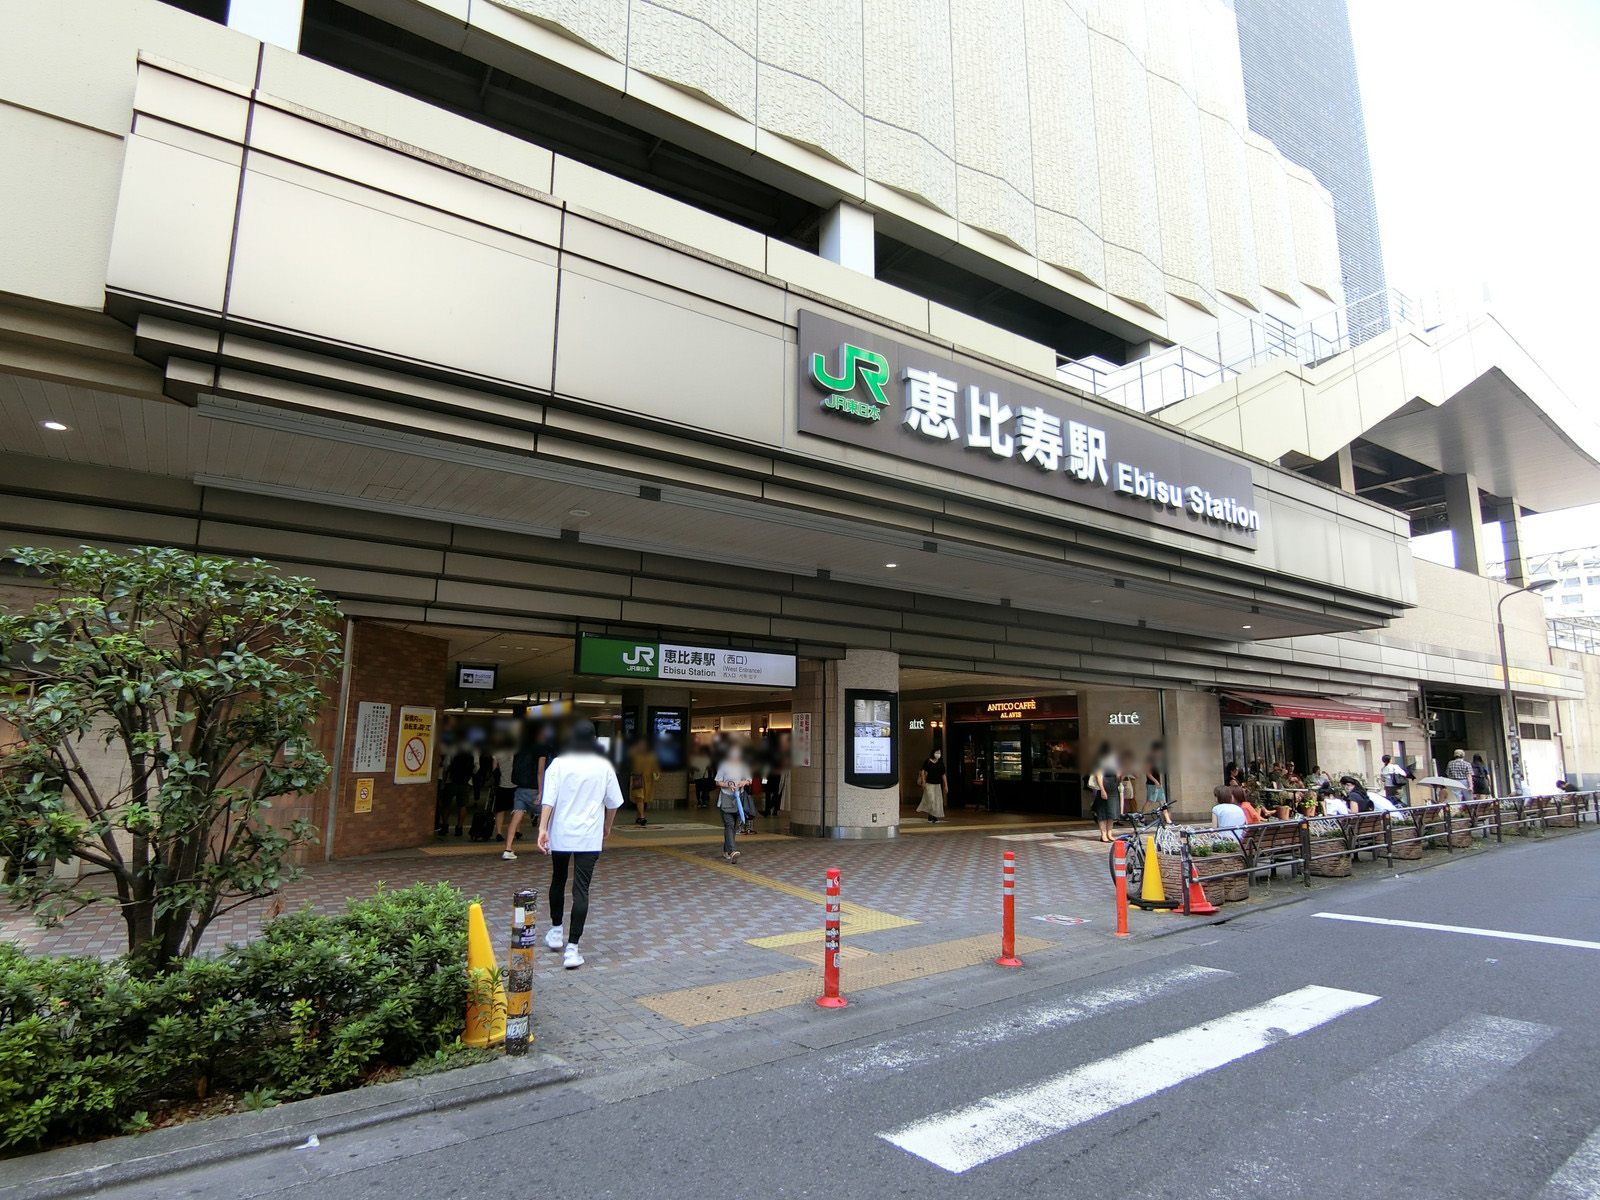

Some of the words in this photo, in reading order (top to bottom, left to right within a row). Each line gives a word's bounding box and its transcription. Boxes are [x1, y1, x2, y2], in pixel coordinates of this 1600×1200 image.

[809, 342, 890, 406] JR
[821, 393, 881, 421] JR東日本
[902, 366, 1109, 487] 恵比寿駅
[1113, 462, 1183, 508] Ebisu
[1185, 485, 1260, 532] Station
[622, 646, 655, 666] JR
[664, 649, 716, 667] 恵比寿駅
[663, 666, 686, 676] Ebisu
[688, 667, 716, 677] Station
[987, 702, 1014, 712] ANTICO
[1014, 699, 1037, 710] CAFFÈ
[908, 718, 925, 729] atré
[1108, 711, 1140, 725] atré
